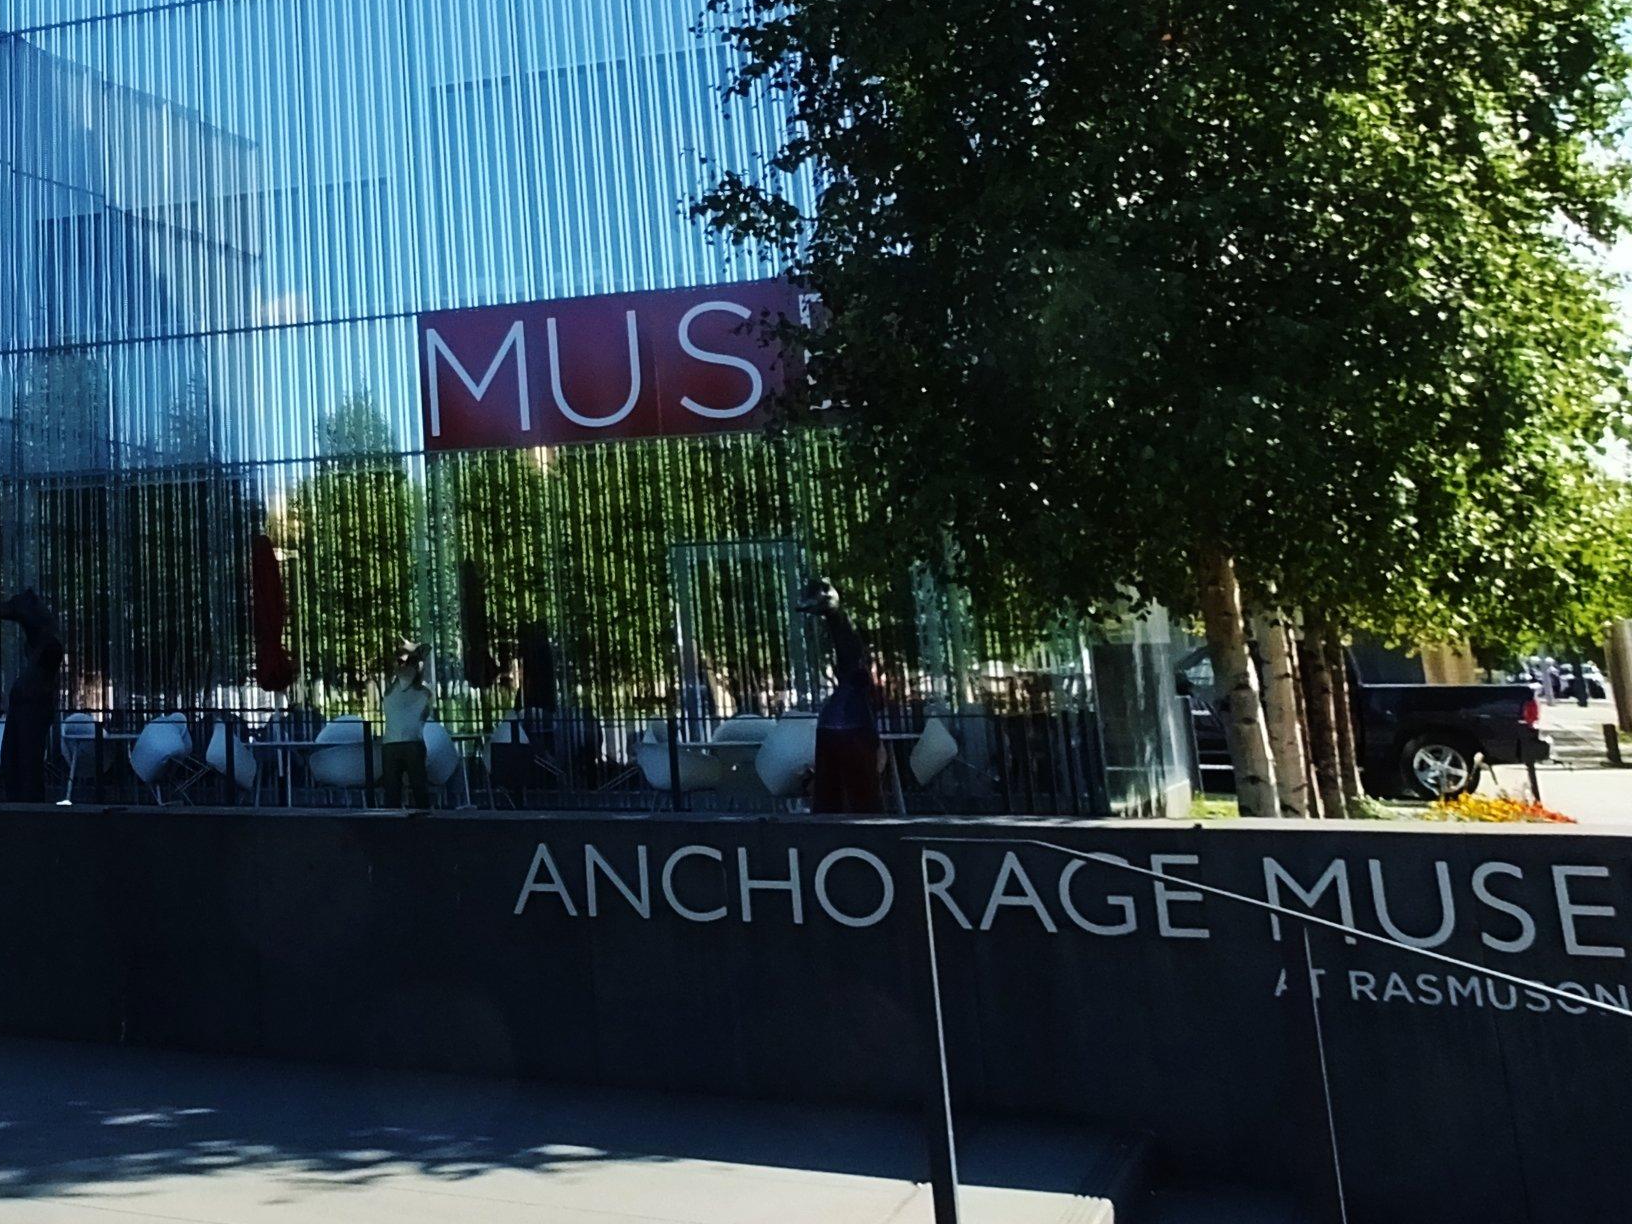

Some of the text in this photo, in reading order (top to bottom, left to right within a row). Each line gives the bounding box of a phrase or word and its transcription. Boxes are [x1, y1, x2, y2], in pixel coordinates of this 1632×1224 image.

[514, 843, 1626, 958] ANCHORAGE MUSE
[1348, 970, 1631, 1016] RASMUSON
